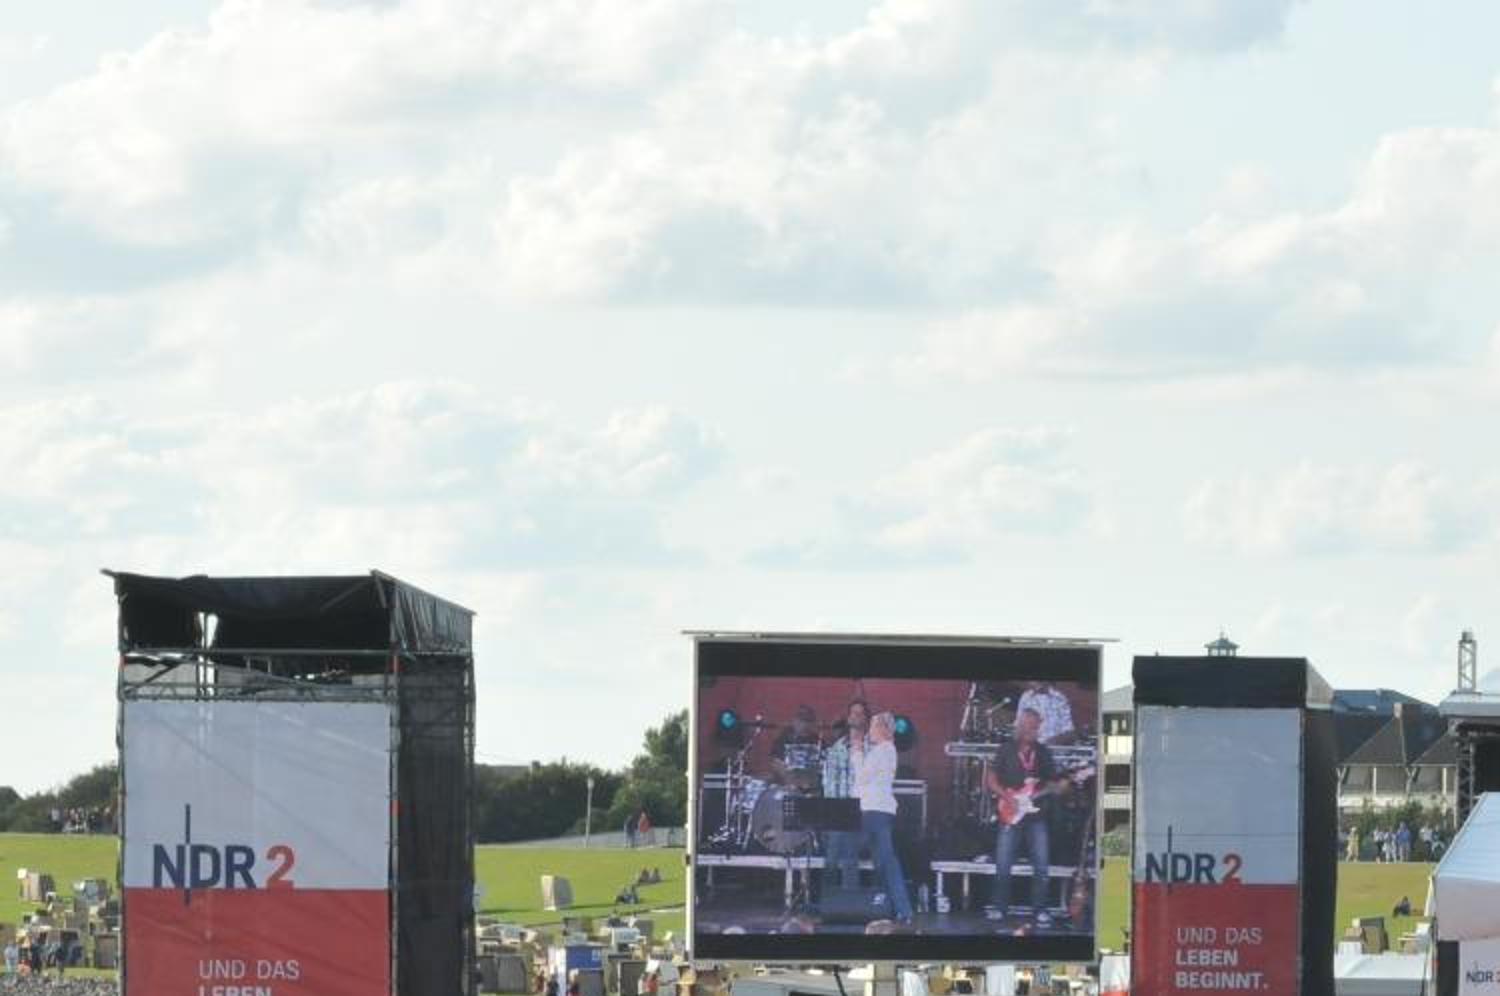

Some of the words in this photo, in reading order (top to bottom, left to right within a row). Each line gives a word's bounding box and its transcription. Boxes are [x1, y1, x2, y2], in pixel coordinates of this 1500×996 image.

[153, 844, 257, 889] NDR
[266, 845, 295, 889] 2
[1145, 853, 1216, 883] NDR
[1223, 853, 1243, 884] 2
[1177, 927, 1217, 944] UND
[1225, 926, 1264, 945] DAS
[1175, 949, 1239, 966] LEBEN
[199, 959, 246, 979] UND
[256, 959, 301, 980] DAS
[1465, 970, 1493, 984] NDR
[1174, 971, 1270, 989] BEGINNT.
